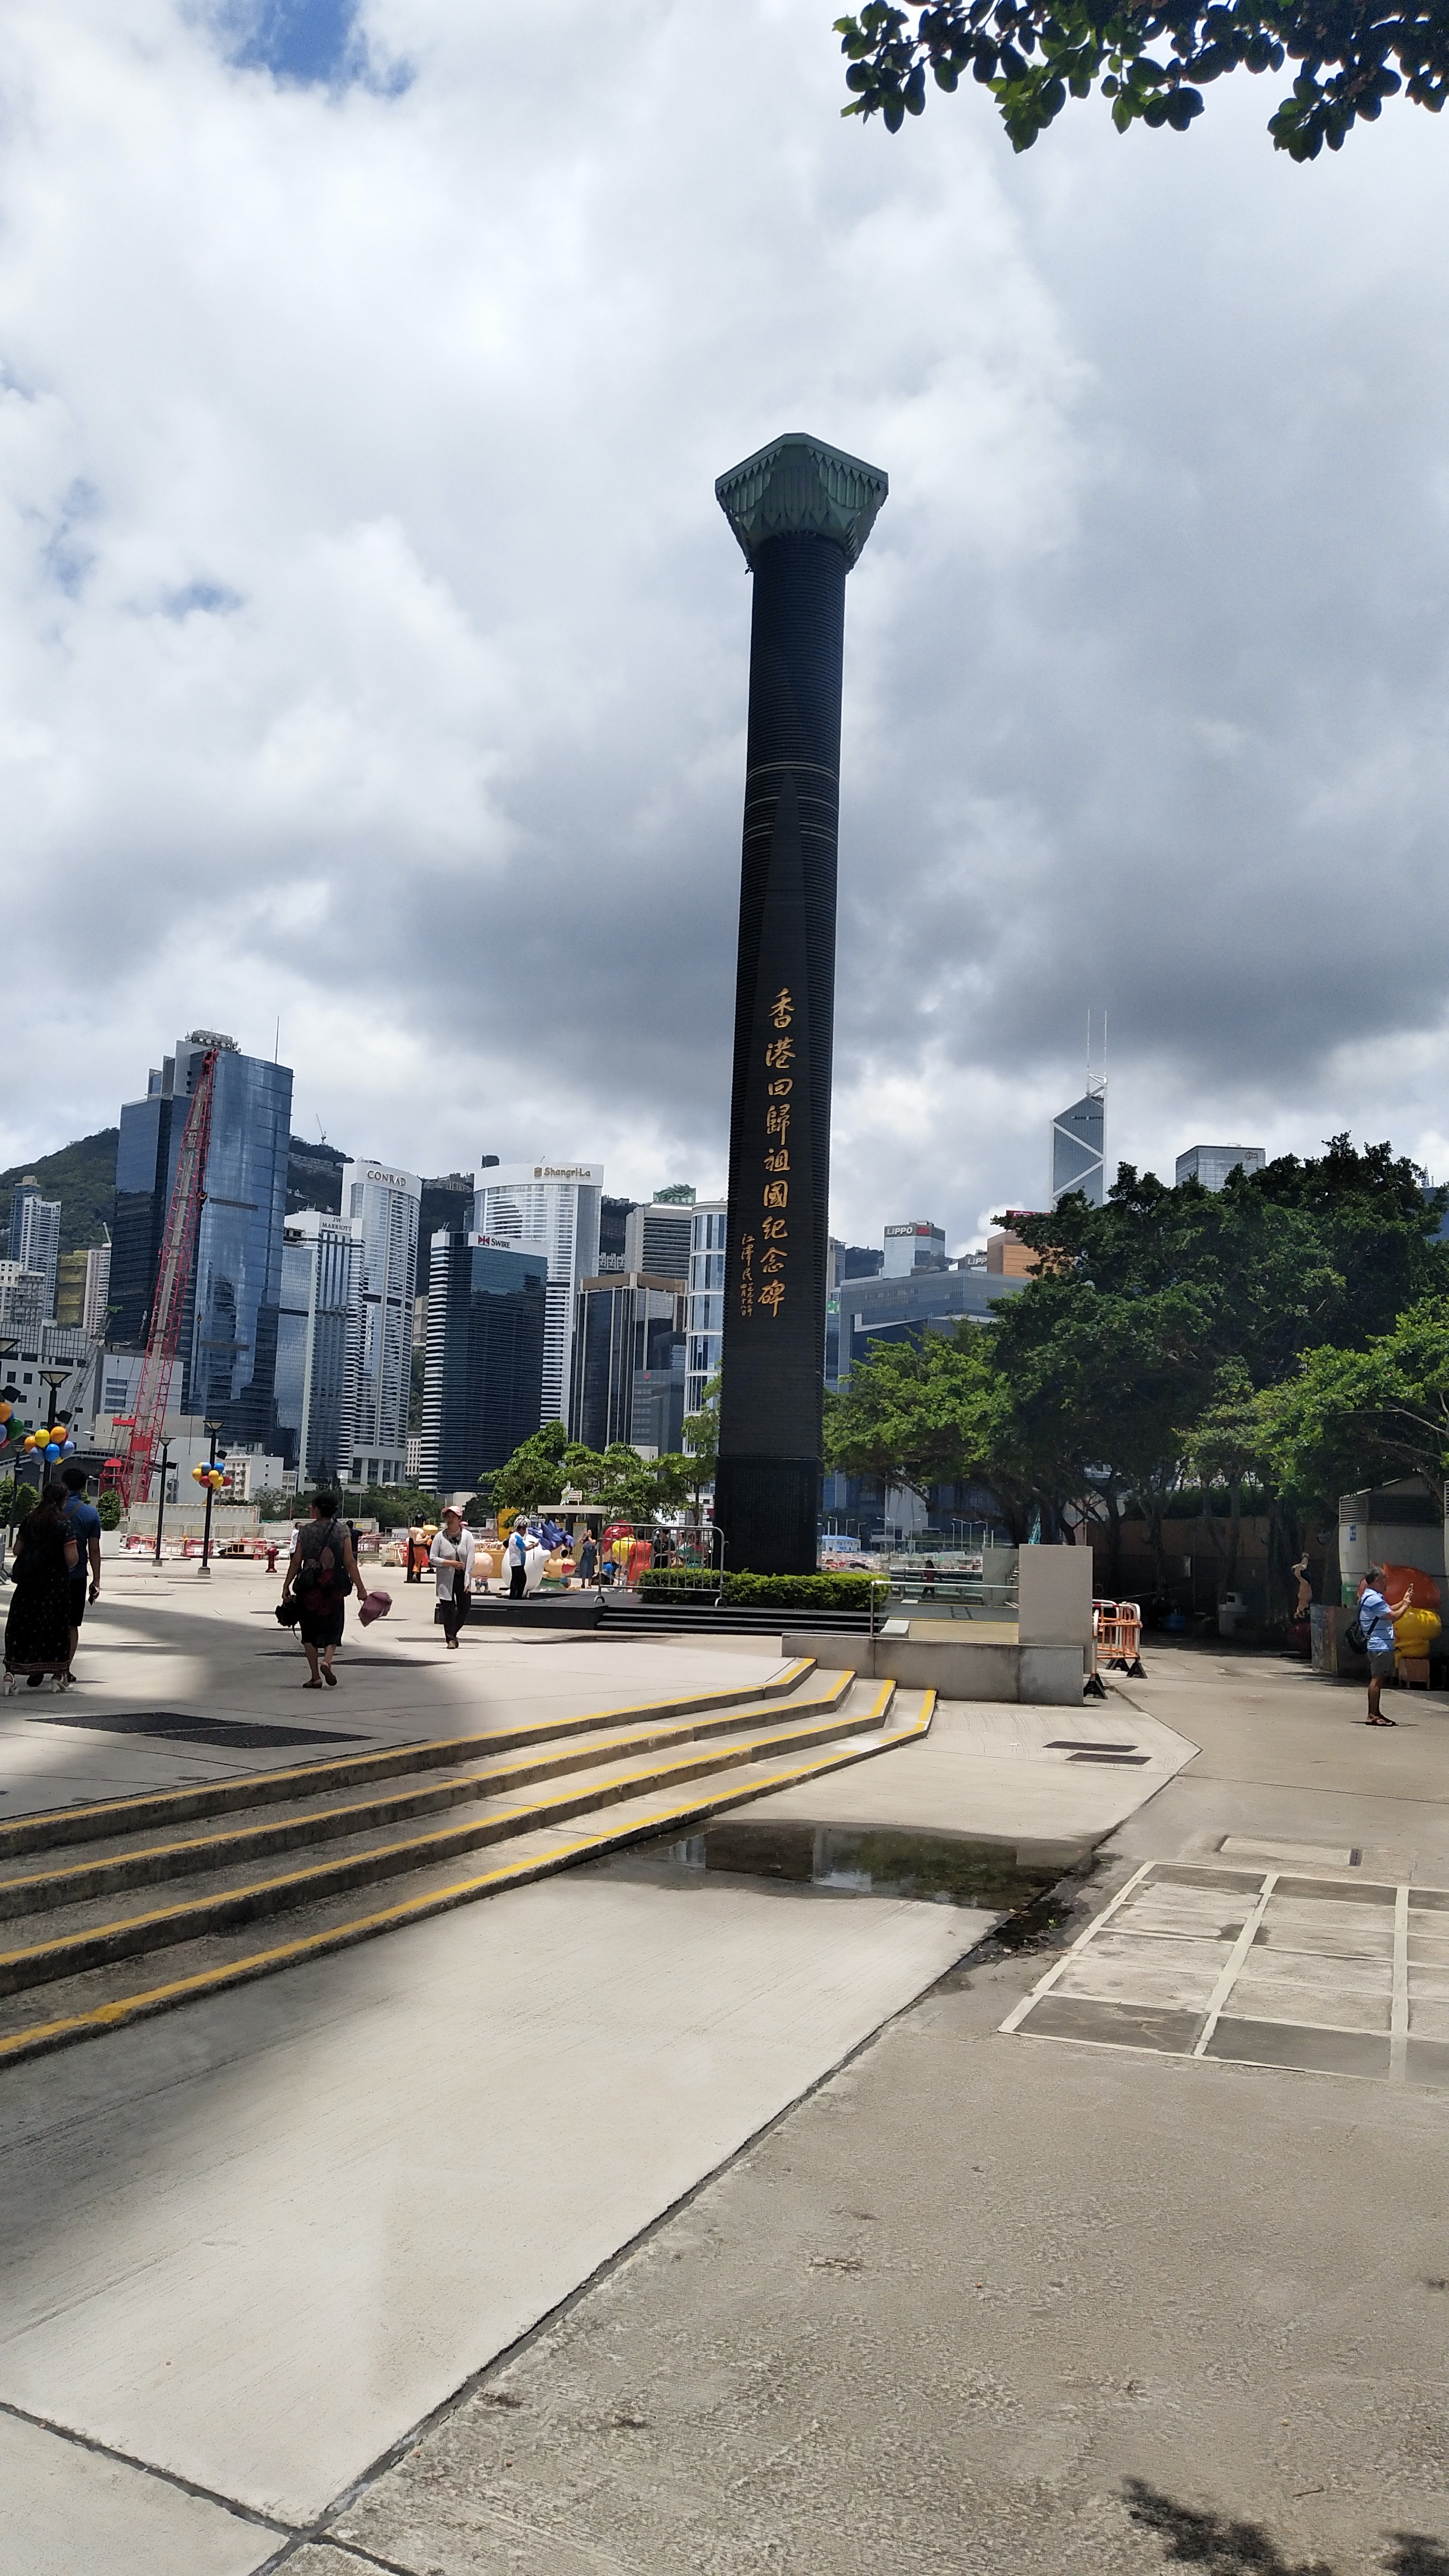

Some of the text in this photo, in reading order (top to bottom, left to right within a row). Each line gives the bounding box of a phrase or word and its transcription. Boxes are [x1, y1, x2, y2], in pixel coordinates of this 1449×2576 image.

[758, 987, 795, 1318] 香港回歸祖國紀念碑
[544, 1167, 591, 1178] Shangri-La
[367, 1170, 406, 1186] CONRAD
[322, 1222, 352, 1232] MARRIOTT
[887, 1227, 913, 1235] LIPPO
[491, 1238, 510, 1248] SWIRE
